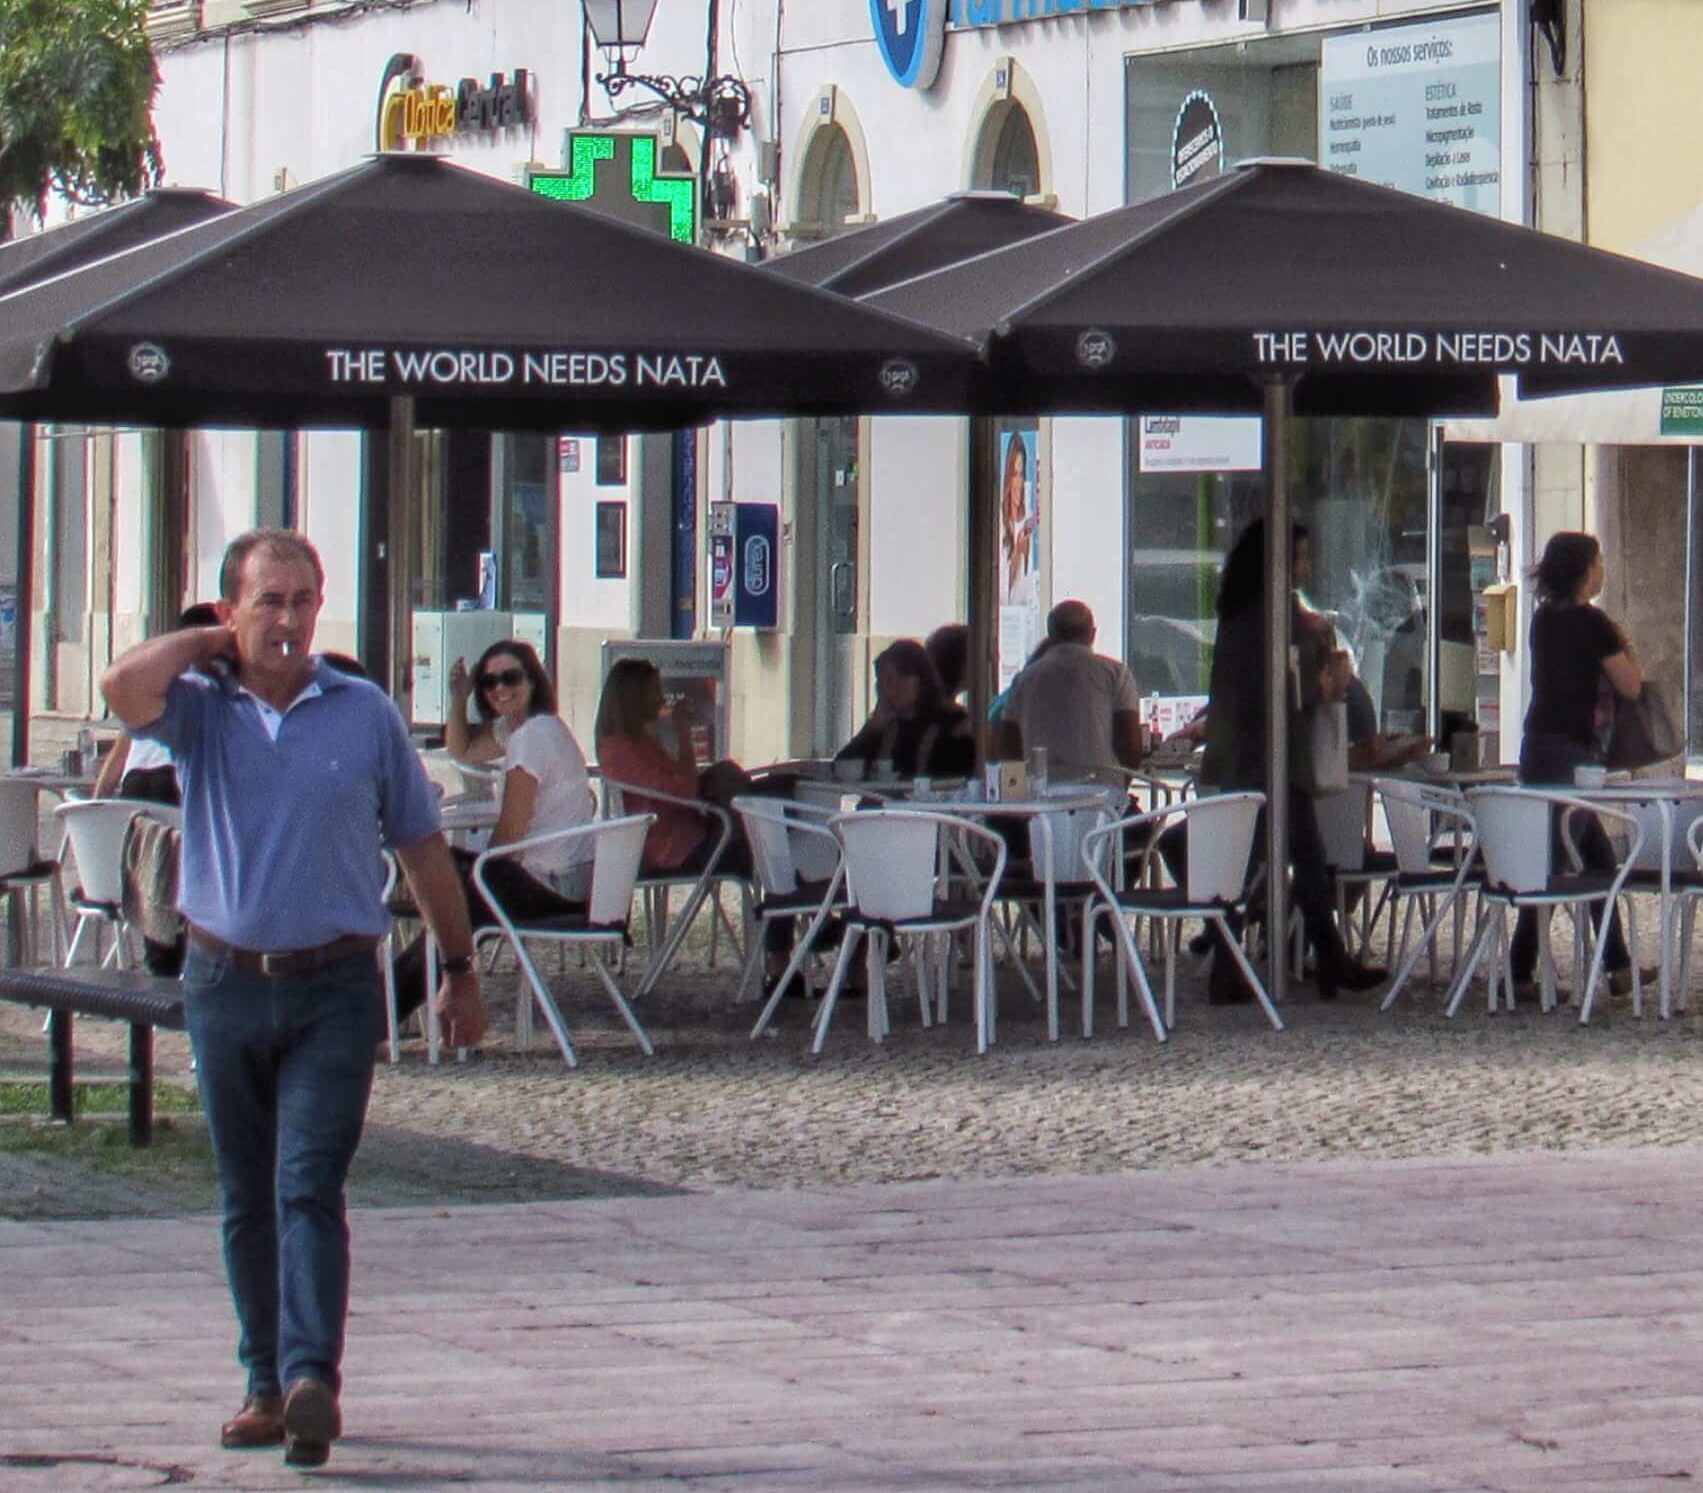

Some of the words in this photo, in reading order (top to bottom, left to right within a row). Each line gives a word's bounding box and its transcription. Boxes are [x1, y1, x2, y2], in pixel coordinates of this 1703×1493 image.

[1366, 45, 1378, 67] Os
[1380, 44, 1412, 65] nossos
[1413, 35, 1453, 64] serviços:
[1254, 333, 1307, 362] THE
[1315, 333, 1427, 363] WORLD
[1435, 333, 1531, 363] NEEDS
[1540, 335, 1623, 364] NATA
[327, 350, 385, 383] THE
[392, 351, 514, 385] WORLD
[523, 354, 627, 386] NEEDS
[635, 355, 726, 388] NATA
